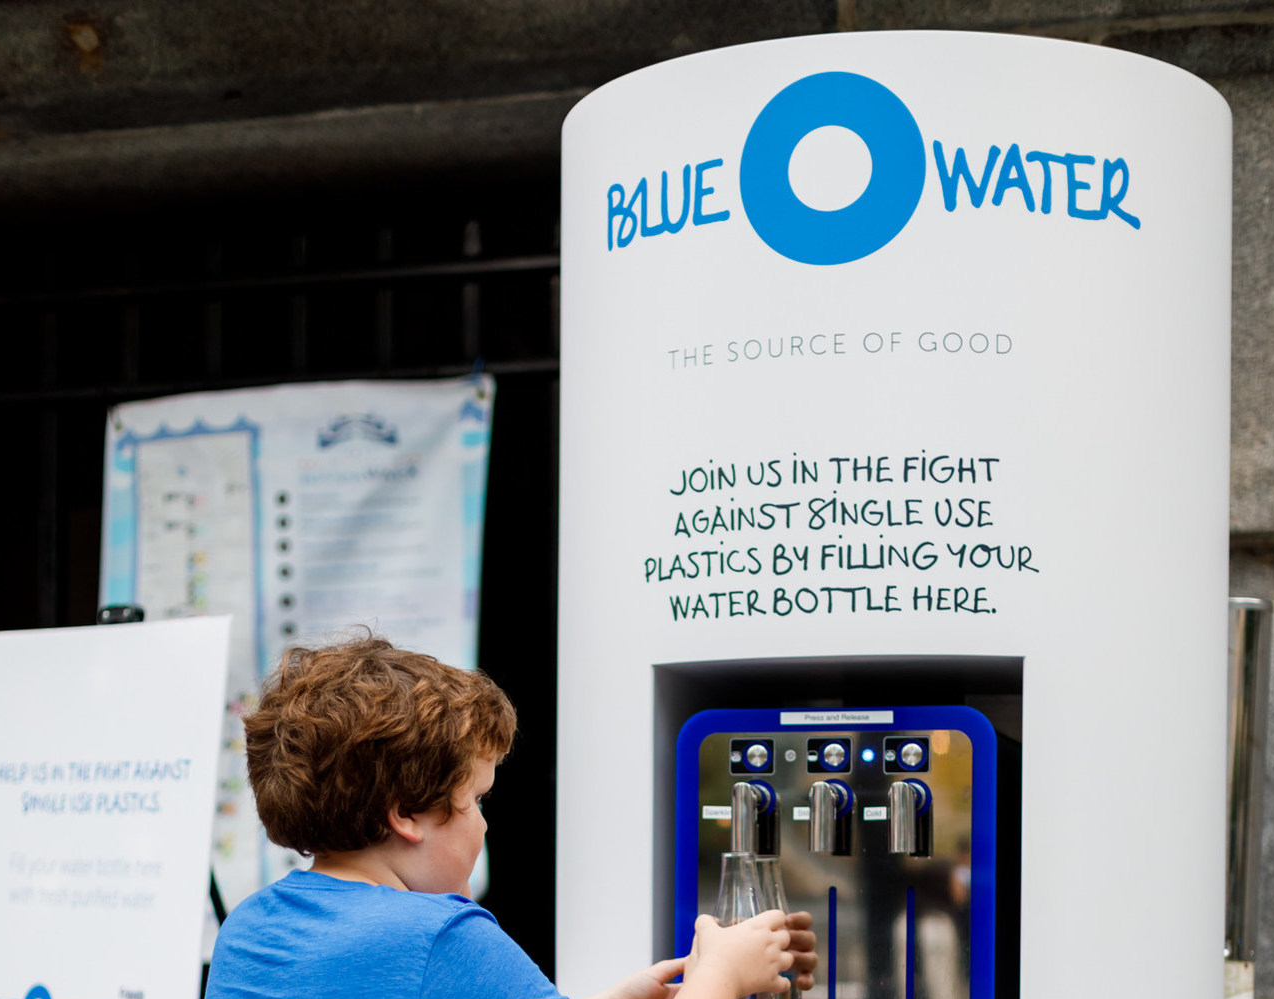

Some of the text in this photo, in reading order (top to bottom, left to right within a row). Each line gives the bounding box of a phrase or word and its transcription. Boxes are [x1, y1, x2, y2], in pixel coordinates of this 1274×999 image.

[607, 158, 731, 252] BLUE
[933, 140, 1142, 230] WATER
[667, 332, 1013, 370] THE SOURCE OF GOOD
[670, 459, 737, 496] JOIN
[747, 460, 783, 487] US
[829, 456, 894, 484] THE
[903, 449, 1001, 484] FIGHT
[674, 497, 801, 538] AGAINST
[935, 498, 994, 528] USE
[644, 534, 1040, 583] PLASTICS BY FILLING YOUR
[670, 585, 997, 621] WATER BOTTLE HERE.
[804, 712, 870, 721] Press and Release
[31, 761, 49, 783] US
[68, 761, 91, 782] THE
[865, 809, 882, 817] Cold
